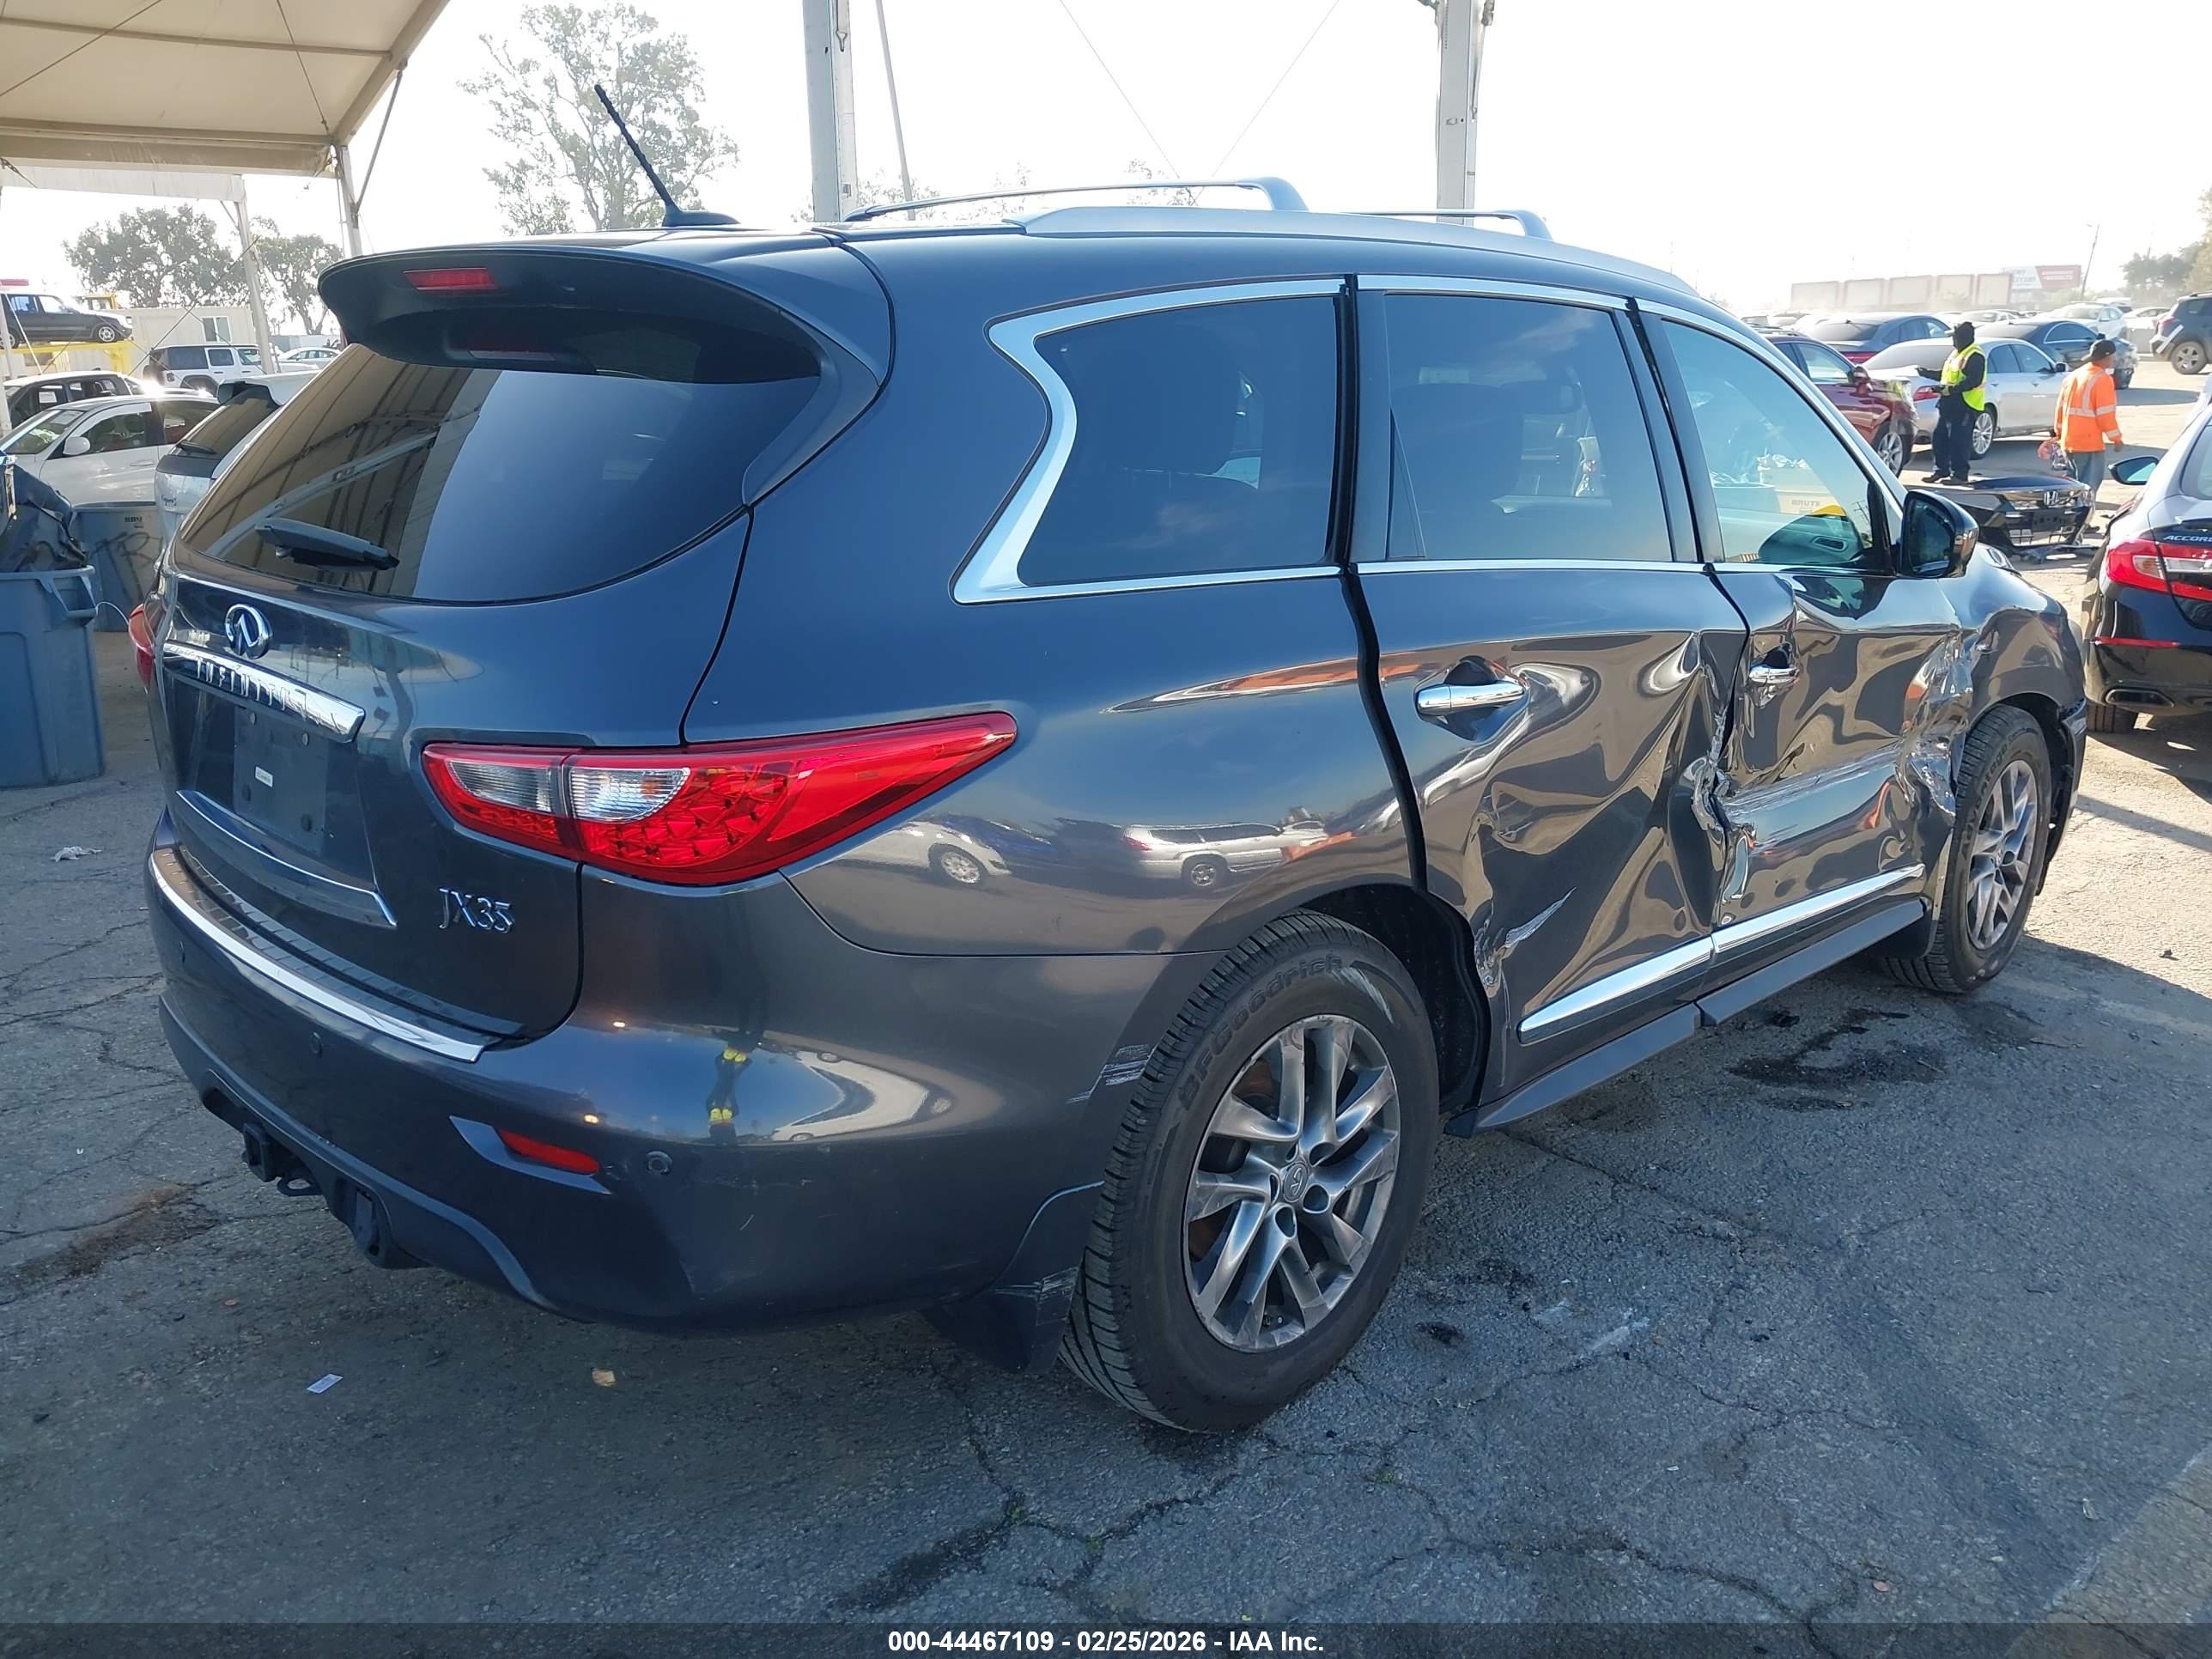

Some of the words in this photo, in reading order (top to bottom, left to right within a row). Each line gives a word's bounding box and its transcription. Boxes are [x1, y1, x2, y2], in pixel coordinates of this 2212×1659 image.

[196, 656, 292, 712] INFINITI
[439, 888, 515, 933] JX35
[1178, 952, 1343, 1111] BFGoodrich
